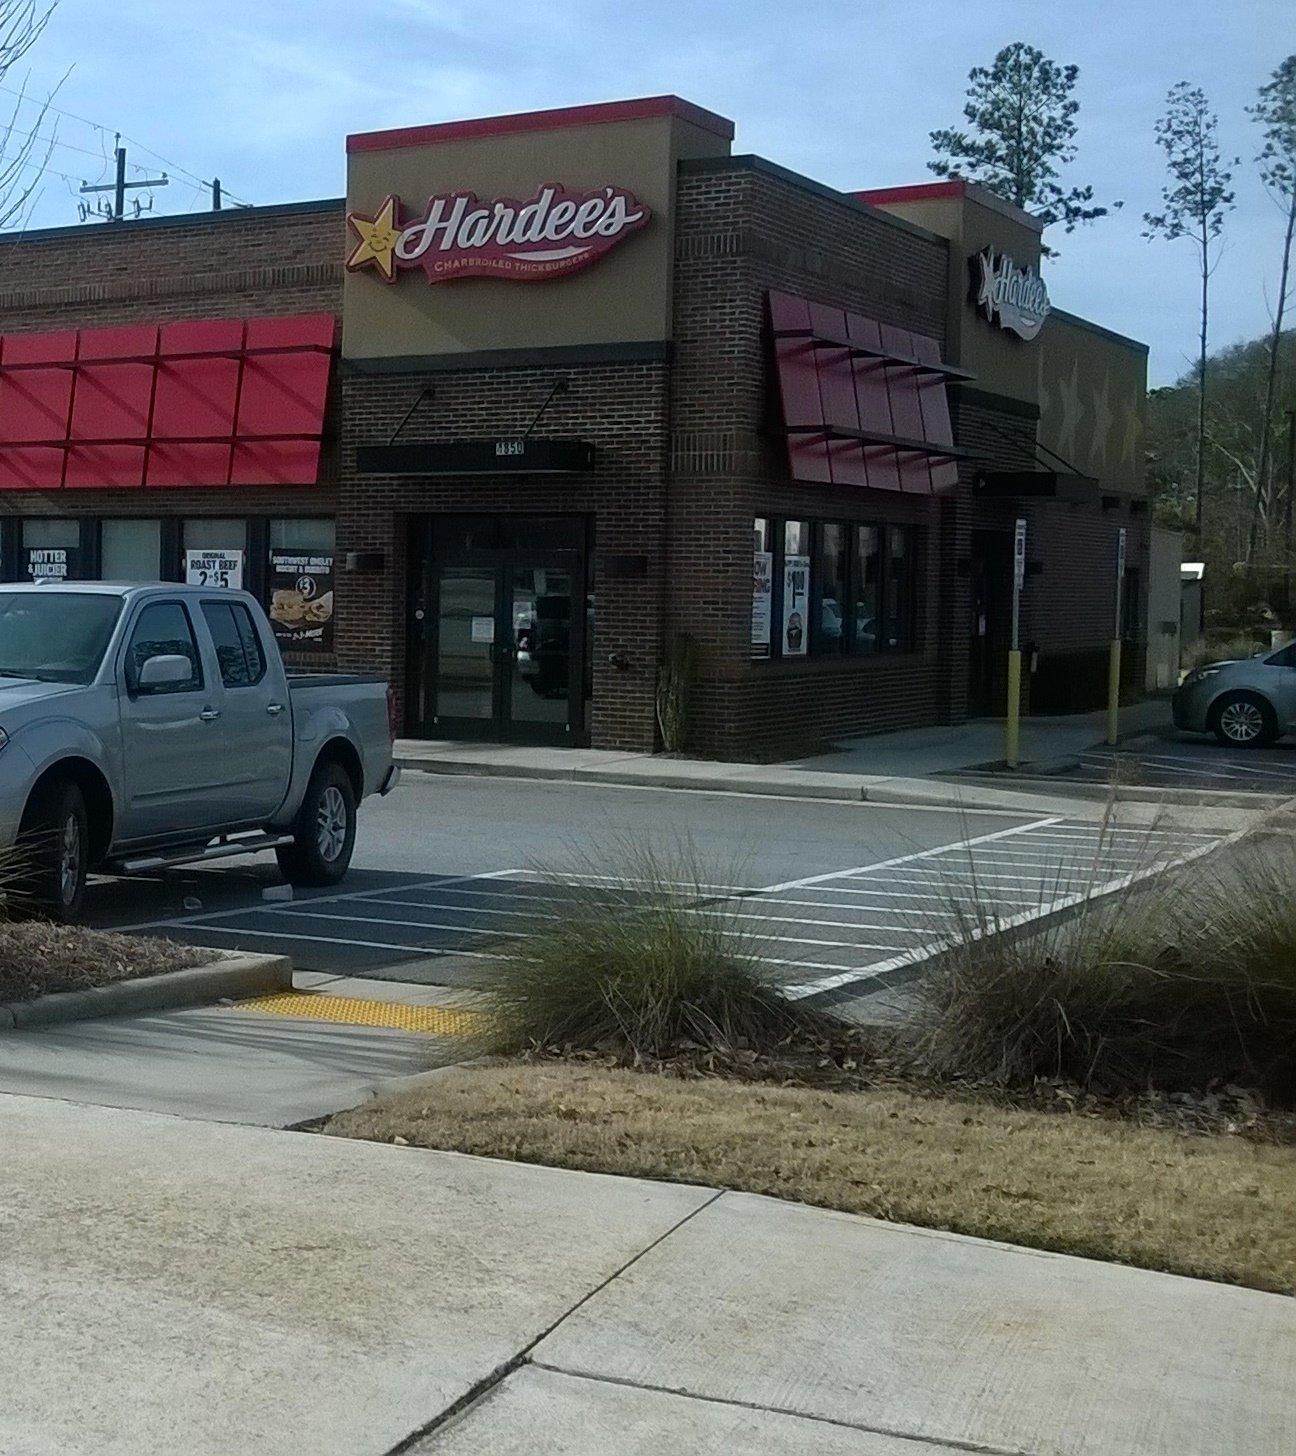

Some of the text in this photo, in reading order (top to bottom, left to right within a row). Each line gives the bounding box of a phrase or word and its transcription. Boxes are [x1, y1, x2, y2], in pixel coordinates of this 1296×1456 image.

[395, 188, 643, 260] Hardee's
[434, 257, 512, 272] CHARBROILED
[30, 550, 67, 563] HOTTER
[191, 559, 238, 571] ROAST BEEF
